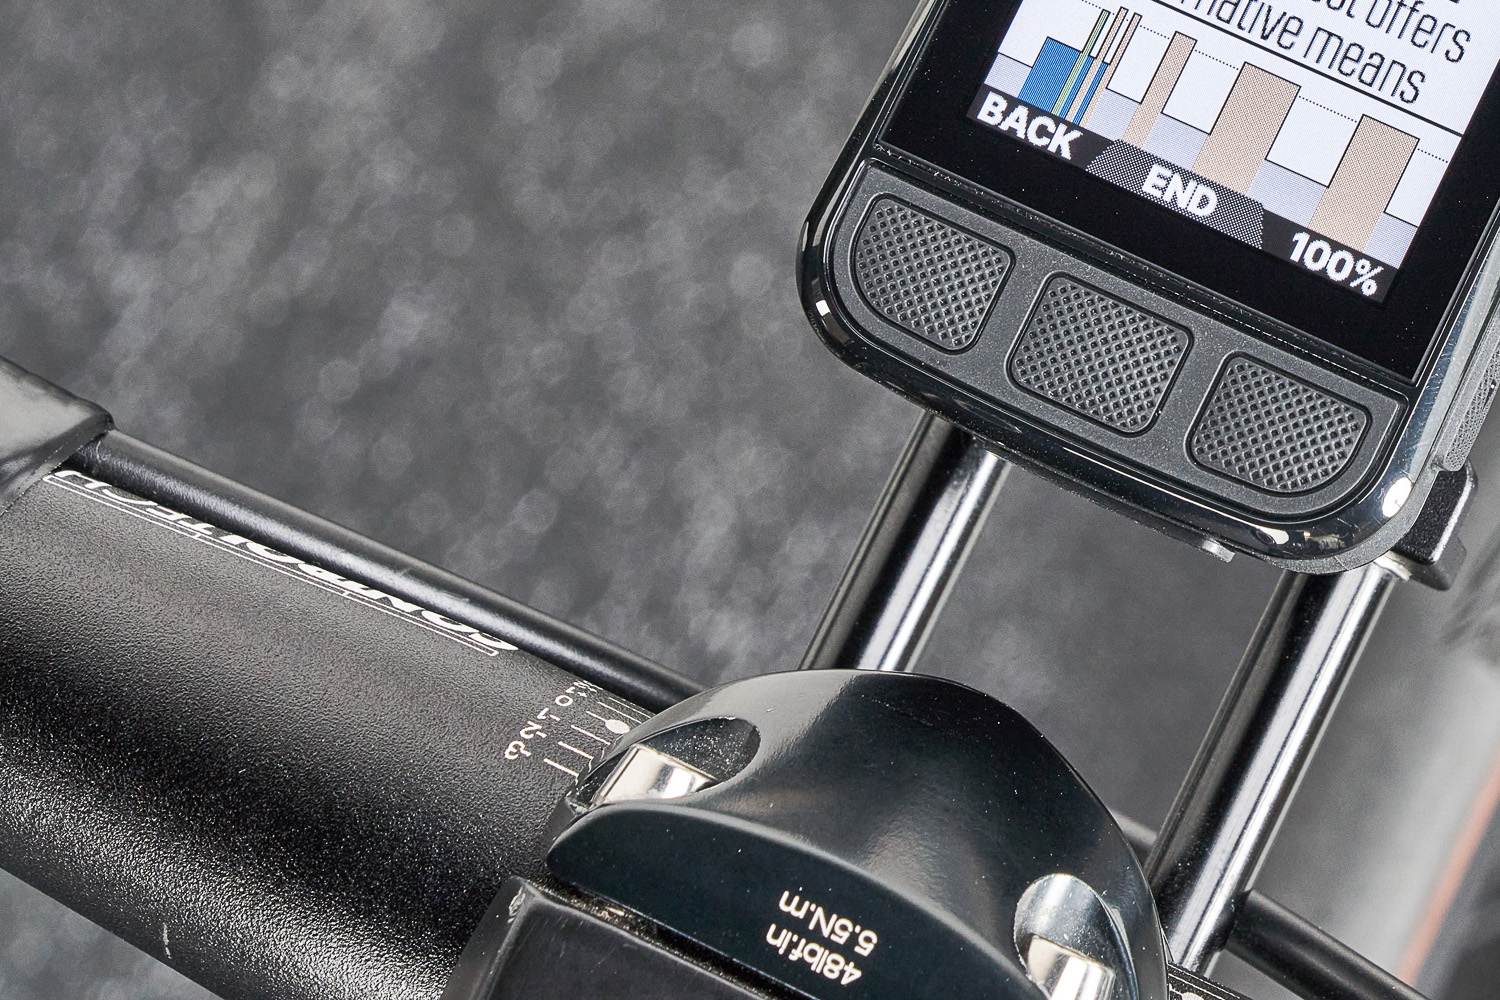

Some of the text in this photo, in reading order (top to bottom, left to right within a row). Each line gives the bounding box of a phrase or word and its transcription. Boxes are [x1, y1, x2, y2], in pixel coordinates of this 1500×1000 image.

[1302, 26, 1426, 105] means
[976, 91, 1385, 297] BACK END 100%
[778, 890, 878, 957] 5.5N.m
